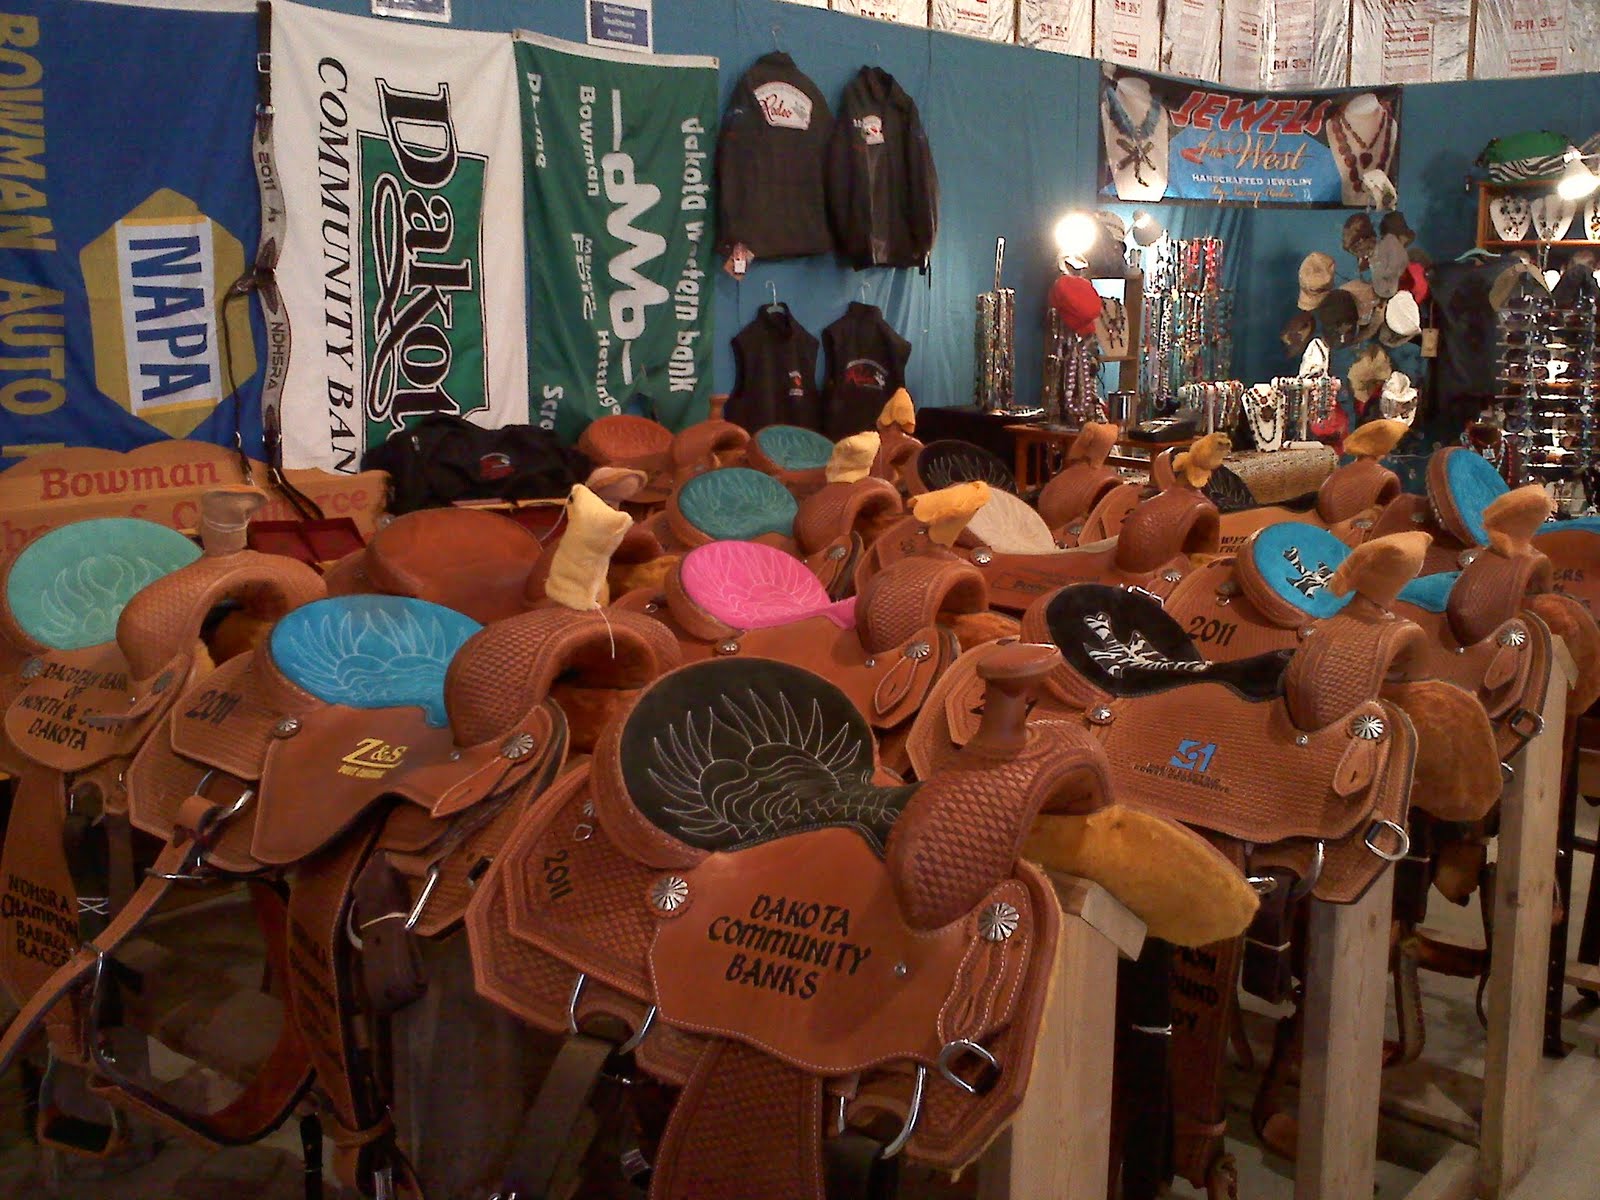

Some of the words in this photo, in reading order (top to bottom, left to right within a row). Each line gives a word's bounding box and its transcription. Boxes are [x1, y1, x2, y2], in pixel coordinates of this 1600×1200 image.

[0, 13, 57, 252] BOWMAN
[578, 85, 600, 197] Bowman
[1228, 130, 1314, 171] West
[258, 151, 278, 192] 2011
[1191, 173, 1264, 186] HANDCRAFTED
[317, 56, 355, 366] COMMUNITY
[368, 77, 471, 434] Dakot
[674, 220, 707, 322] wtern
[0, 279, 66, 418] AUTO
[128, 235, 213, 403] NAPA
[266, 320, 293, 392] NDHSRA
[668, 329, 700, 393] bank
[40, 459, 221, 501] Bowman
[1188, 615, 1240, 647] 2011
[27, 717, 88, 752] DAKOTA
[543, 848, 574, 901] 2011
[708, 916, 872, 977] COMMUNITY
[749, 894, 851, 938] DAKOTA
[725, 953, 821, 1001] BANKS
